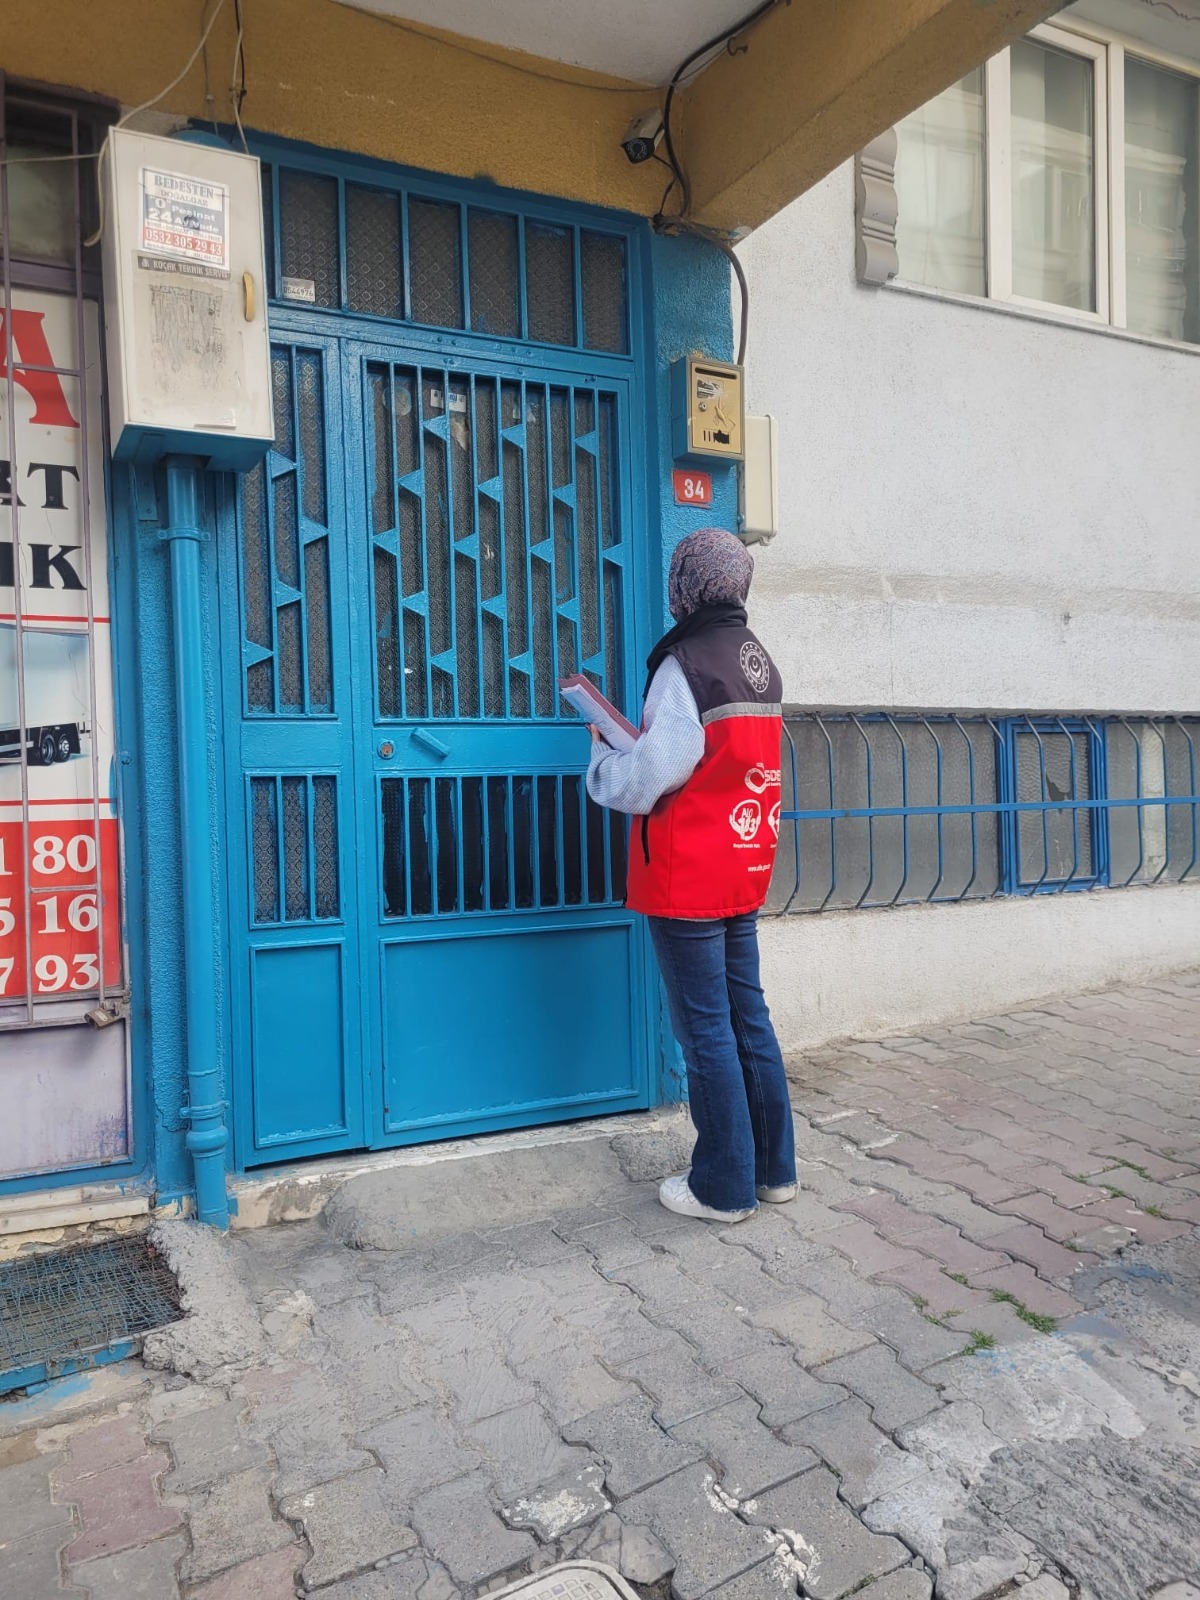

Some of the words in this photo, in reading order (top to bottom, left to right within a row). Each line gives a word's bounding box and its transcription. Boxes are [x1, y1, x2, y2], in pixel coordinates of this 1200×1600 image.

[154, 175, 214, 199] BEDESTEN
[148, 208, 172, 223] 24
[146, 229, 171, 244] 0532
[174, 235, 193, 249] 305
[195, 239, 208, 252] 29
[210, 242, 222, 255] 43
[684, 478, 704, 500] 34
[32, 834, 97, 875] 80
[37, 893, 98, 934] 16
[35, 953, 99, 992] 93
